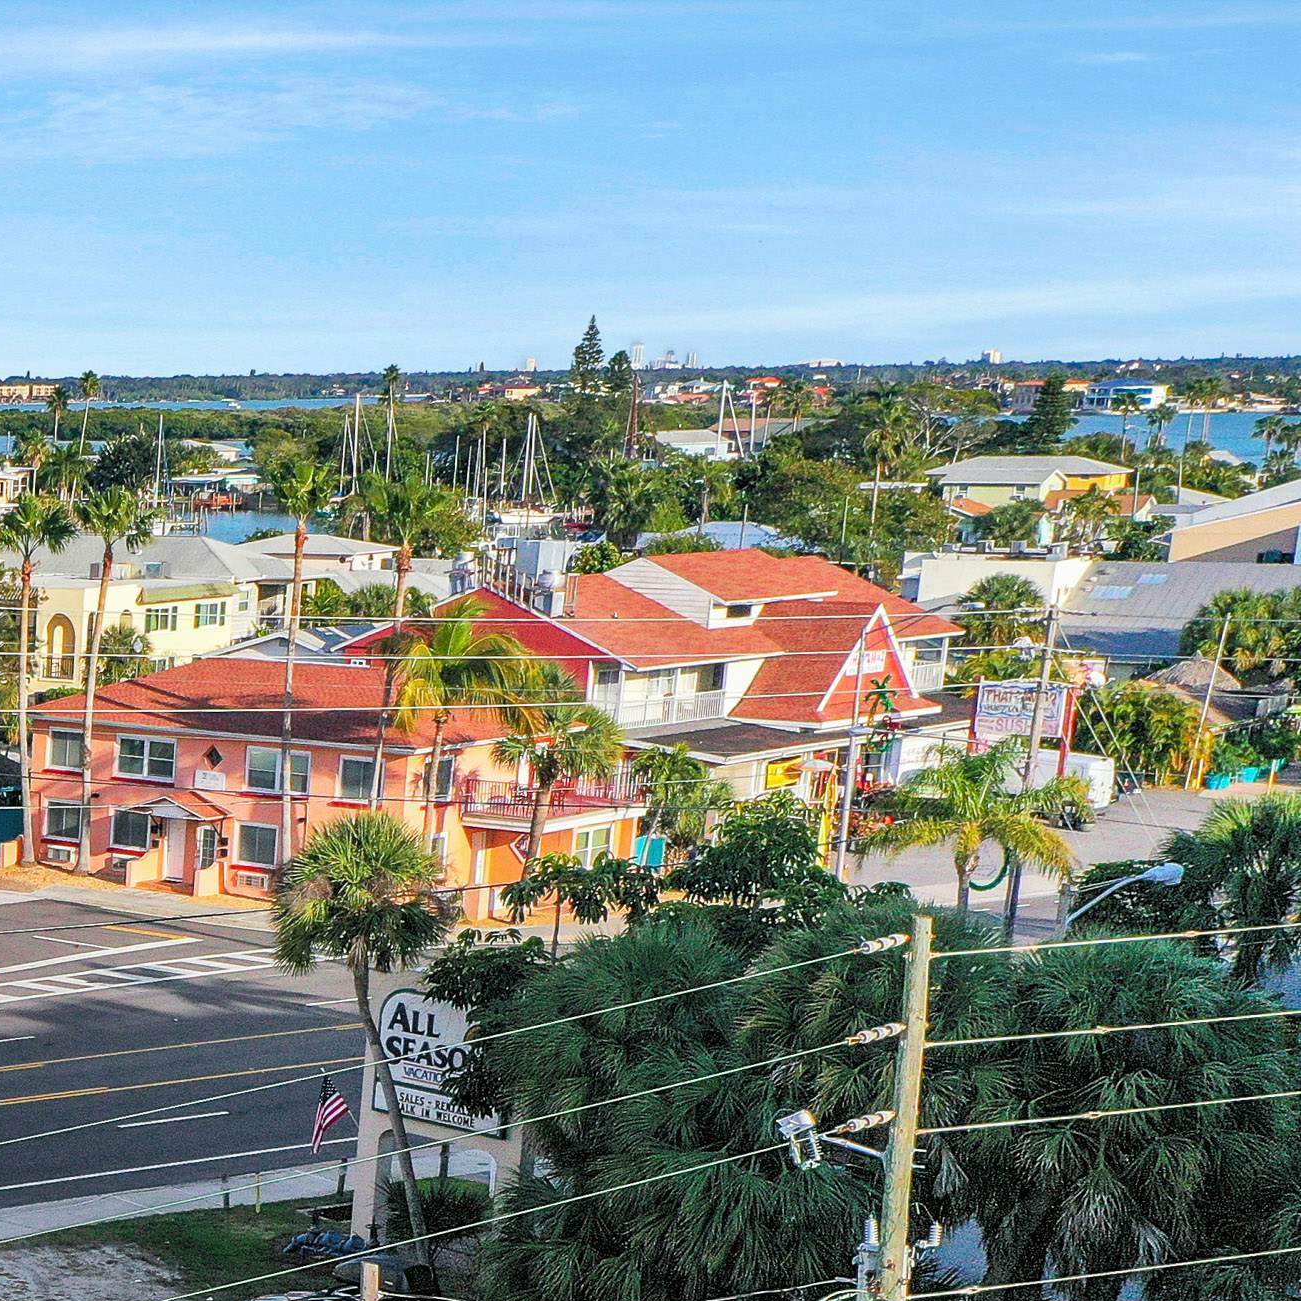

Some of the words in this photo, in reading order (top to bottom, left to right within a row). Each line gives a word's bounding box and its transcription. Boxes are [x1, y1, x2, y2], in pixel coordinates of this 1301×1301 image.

[388, 1002, 441, 1038] ALL
[386, 1036, 467, 1069] SEASO
[404, 1066, 445, 1082] VACATIO
[399, 1092, 425, 1106] SALES
[400, 1104, 415, 1115] ALK
[421, 1108, 430, 1118] IN
[436, 1111, 474, 1127] WELCOME
